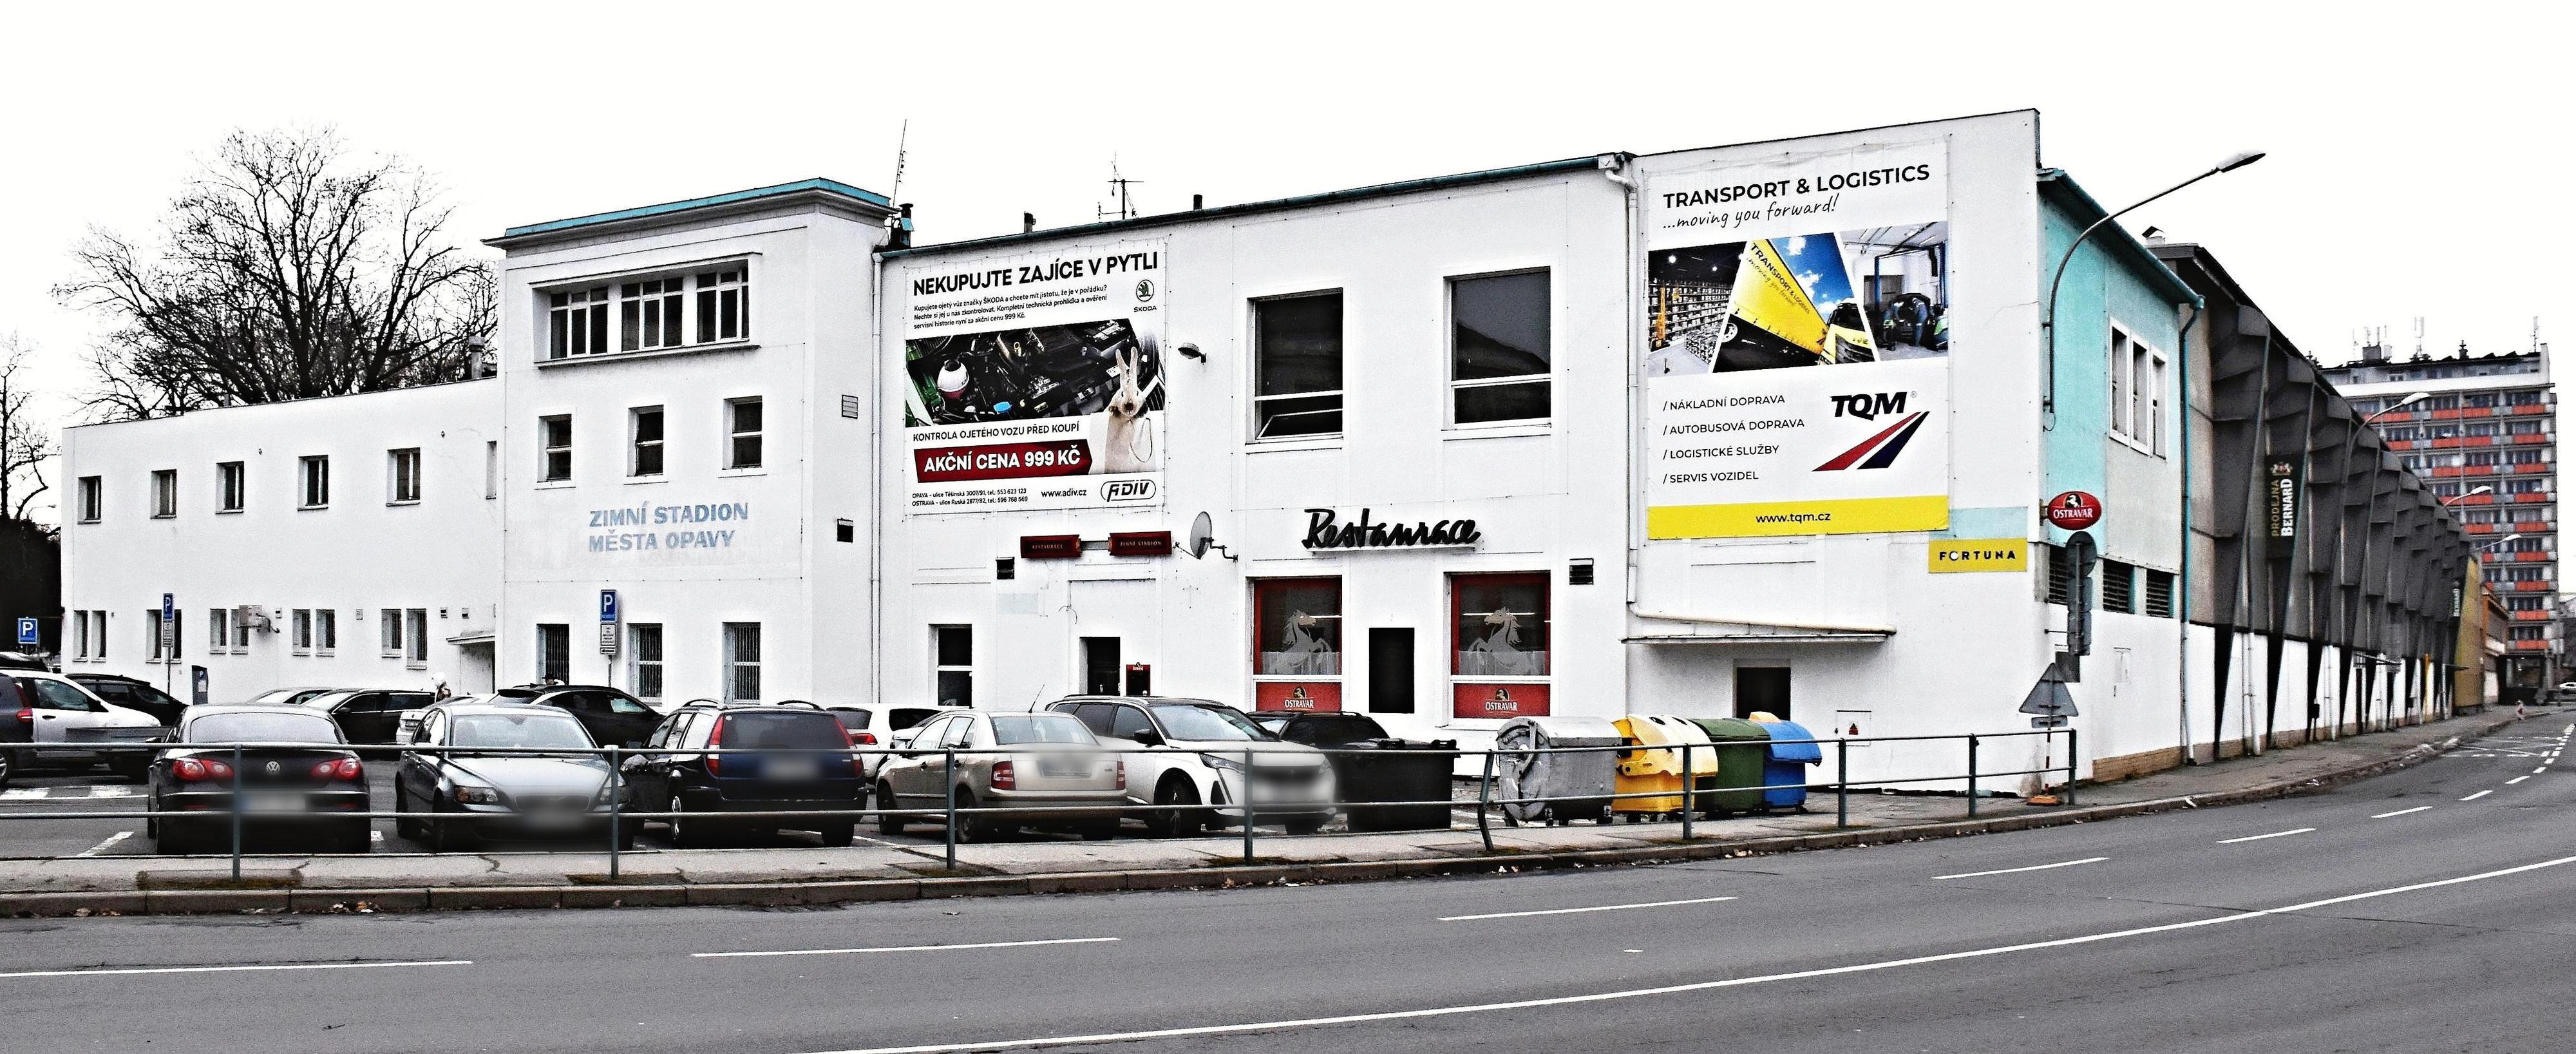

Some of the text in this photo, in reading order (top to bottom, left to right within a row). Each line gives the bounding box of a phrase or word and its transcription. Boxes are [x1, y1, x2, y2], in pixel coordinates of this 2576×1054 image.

[1663, 164, 1930, 209] TRANSPORT & LOGISTICS
[1734, 208, 1760, 229] you
[1766, 193, 1840, 221] forward!
[914, 252, 1158, 296] NEKUPUJTE ZAJÍCE V PYTLI
[1751, 242, 1791, 291] TRANSPORT
[1080, 285, 1107, 294] pořádku?
[1670, 397, 1727, 410] NÁKLADNÍ
[1730, 395, 1785, 407] DOPRAVA
[1830, 391, 1907, 421] TQM
[913, 421, 1079, 441] KONTROLA OJETÉHO VOZU PŘED KOUPÍ
[1669, 420, 1746, 434] AUTOBUSOVÁ
[1749, 419, 1804, 430] DOPRAVA
[923, 445, 1081, 472] AKČNÍ CENA 999 KČ
[1670, 446, 1733, 459] LOGISTICKÉ
[1736, 444, 1779, 455] SLUŽBY
[1670, 474, 1707, 483] SERVIS
[1710, 471, 1759, 481] VOZIDEL
[1041, 488, 1087, 497] www.adiv.cz
[589, 501, 748, 527] ZIMNÍ STADION
[2053, 508, 2093, 519] OSTRAVAR
[2271, 479, 2280, 537] PRODEJNA
[2280, 479, 2293, 537] BERNARD
[1756, 512, 1831, 524] www.tqm.cz
[1302, 508, 1481, 549] Restaurace
[589, 529, 735, 552] MĚSTA OPAVY
[1939, 550, 2016, 561] FORTUNA
[165, 597, 171, 611] P
[603, 594, 613, 612] P
[23, 622, 33, 636] P
[1285, 699, 1314, 709] OSTRAVAR
[1485, 702, 1518, 711] OSTRAVAR
